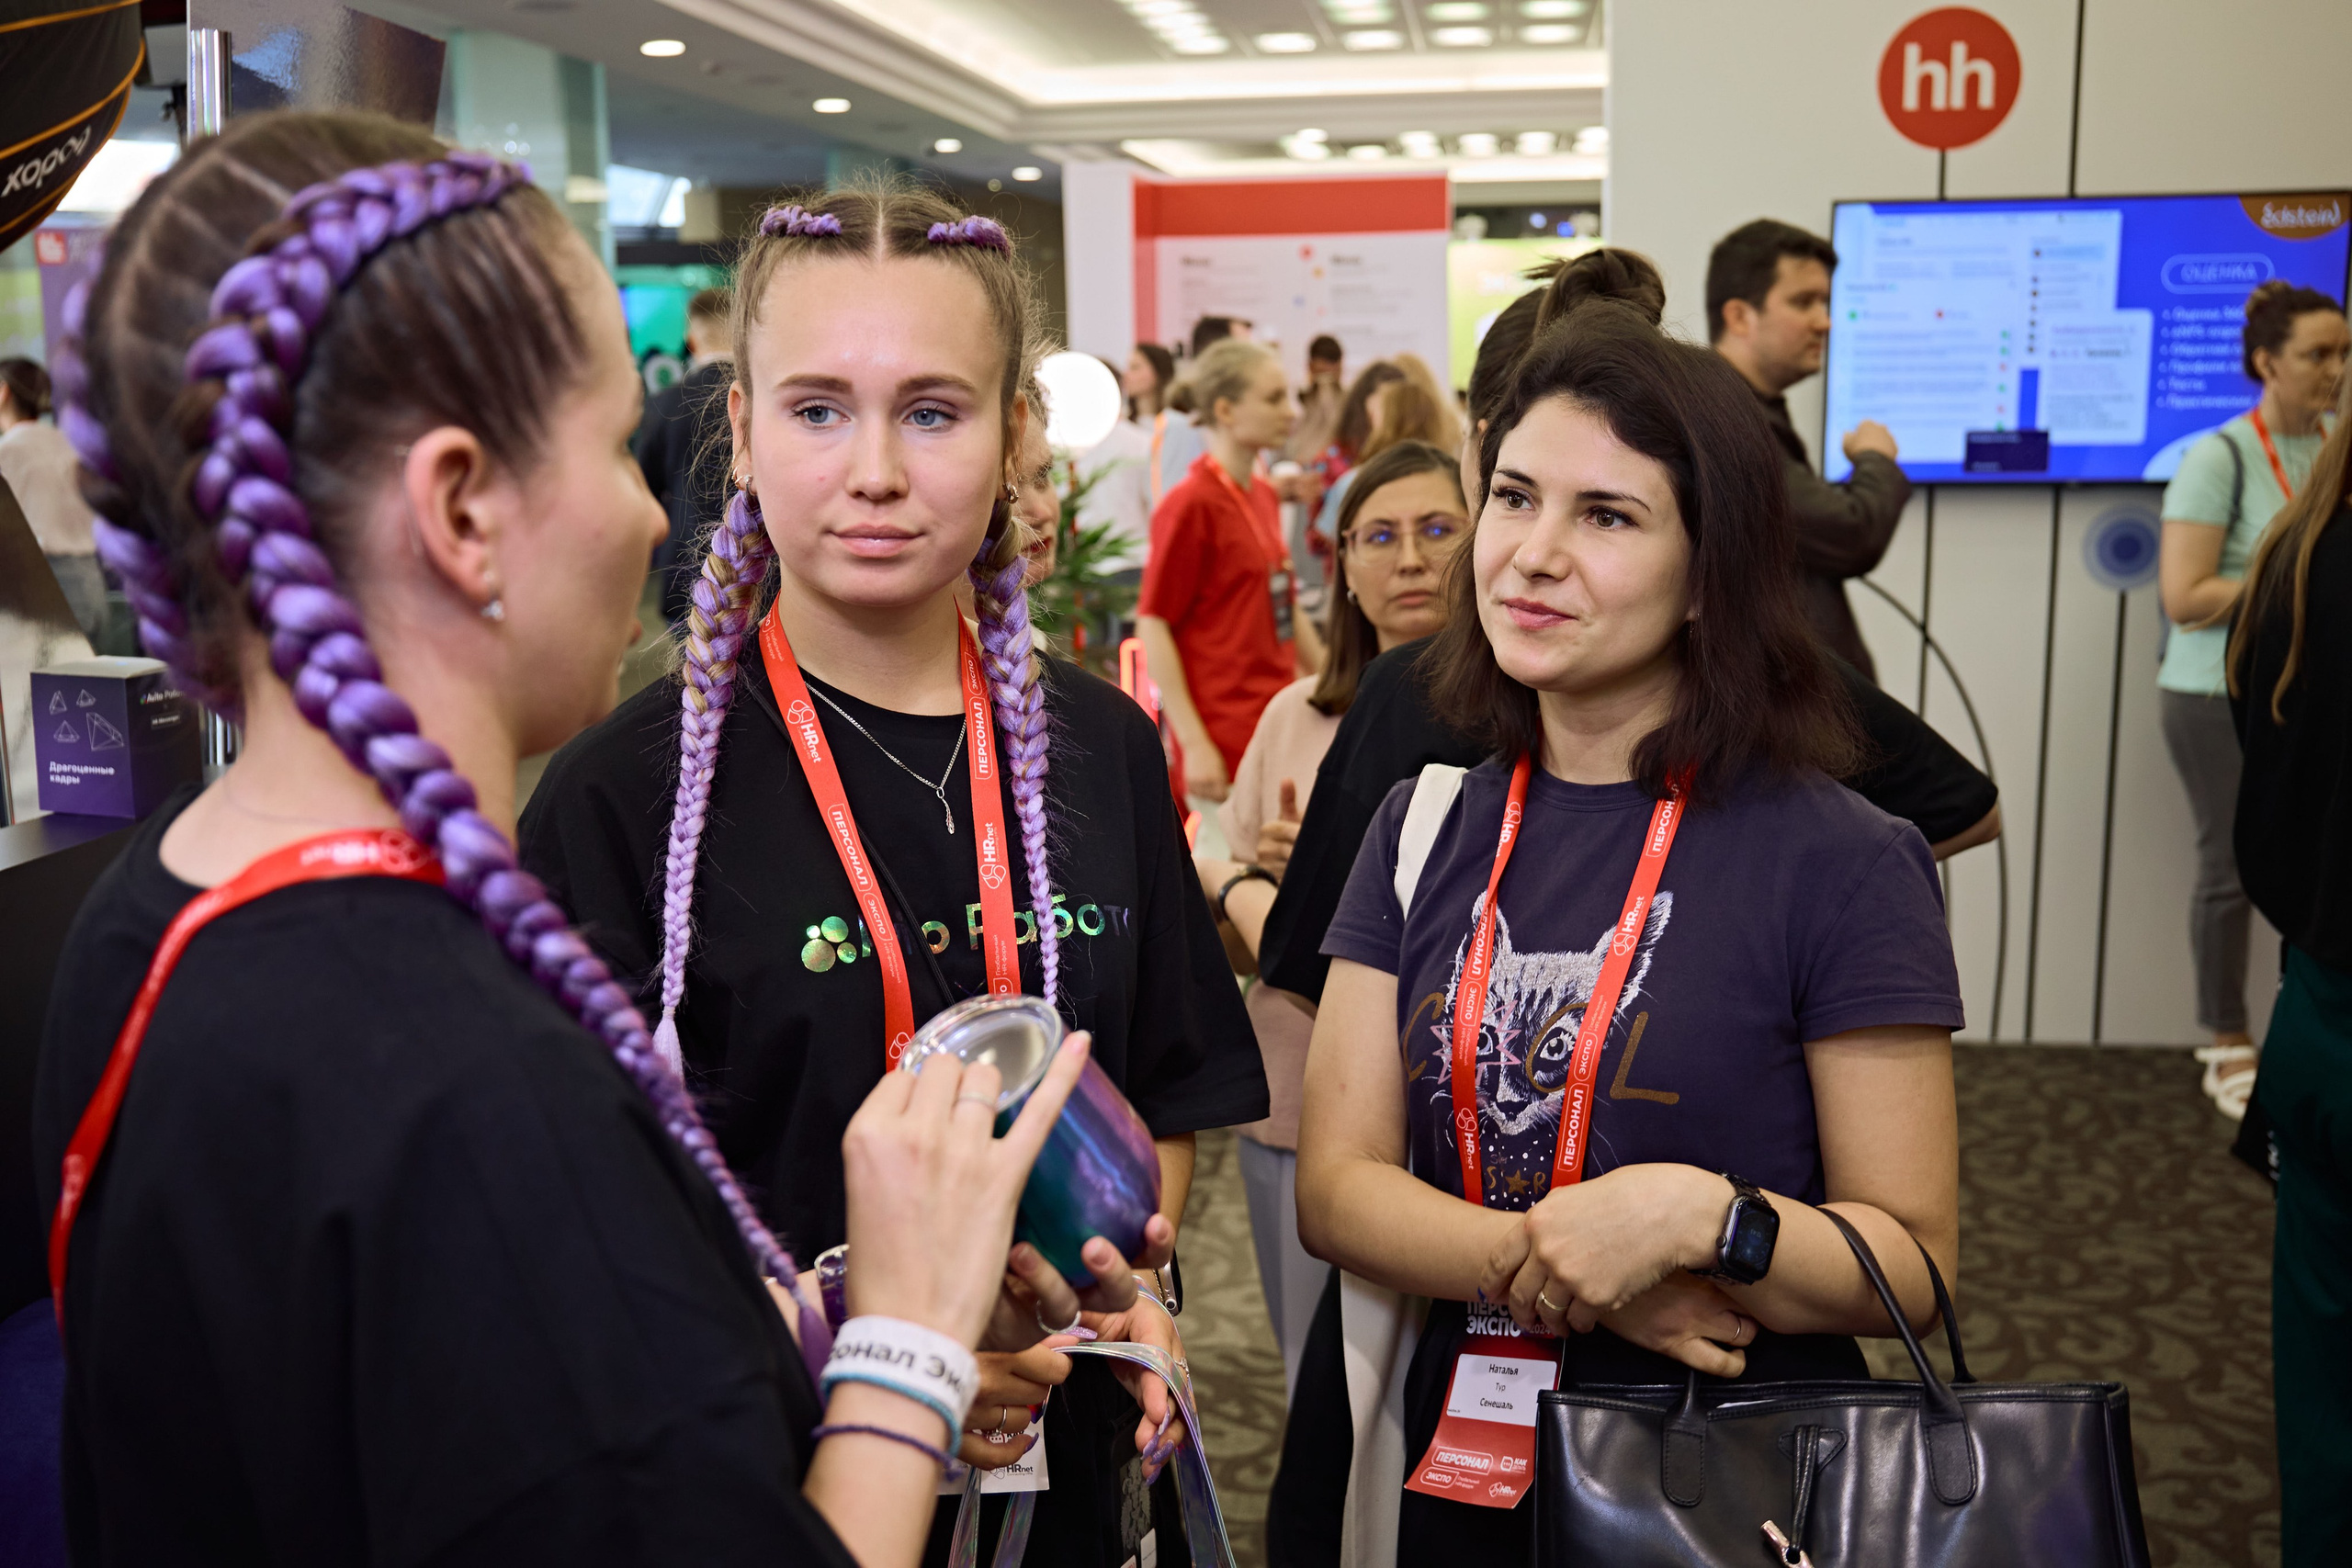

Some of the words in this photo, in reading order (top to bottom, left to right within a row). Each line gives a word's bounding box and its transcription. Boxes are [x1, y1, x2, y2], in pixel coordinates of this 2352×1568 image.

[1902, 41, 1996, 112] hh
[967, 660, 978, 690] ЭКСПО
[800, 723, 821, 763] HRnet
[973, 702, 989, 773] ПЕРСОНАЛ
[50, 761, 115, 775] Драгоценные
[50, 774, 80, 785] кадры
[1652, 784, 1679, 852] ПЕРСОН
[831, 810, 868, 886] ПЕРСОНАЛ
[982, 822, 996, 863] HRnet
[867, 899, 886, 935] ЭКСПО
[1622, 897, 1645, 932] HRnet
[992, 934, 1001, 976] Глобальный
[1464, 987, 1477, 1020] ЭКСПО
[1579, 1039, 1593, 1075] ЭКСПО
[1564, 1089, 1584, 1166] ПЕРСОНАЛ
[1464, 1133, 1475, 1169] HRnet
[1488, 1363, 1519, 1376] Наталья
[1479, 1397, 1513, 1410] Сенешаль
[1496, 1382, 1506, 1393] Тур
[1006, 1464, 1034, 1473] HRnet
[1425, 1472, 1452, 1483] ЭКСПО
[1435, 1451, 1490, 1470] ПЕРСОНАЛ
[1499, 1484, 1518, 1496] HRnet
